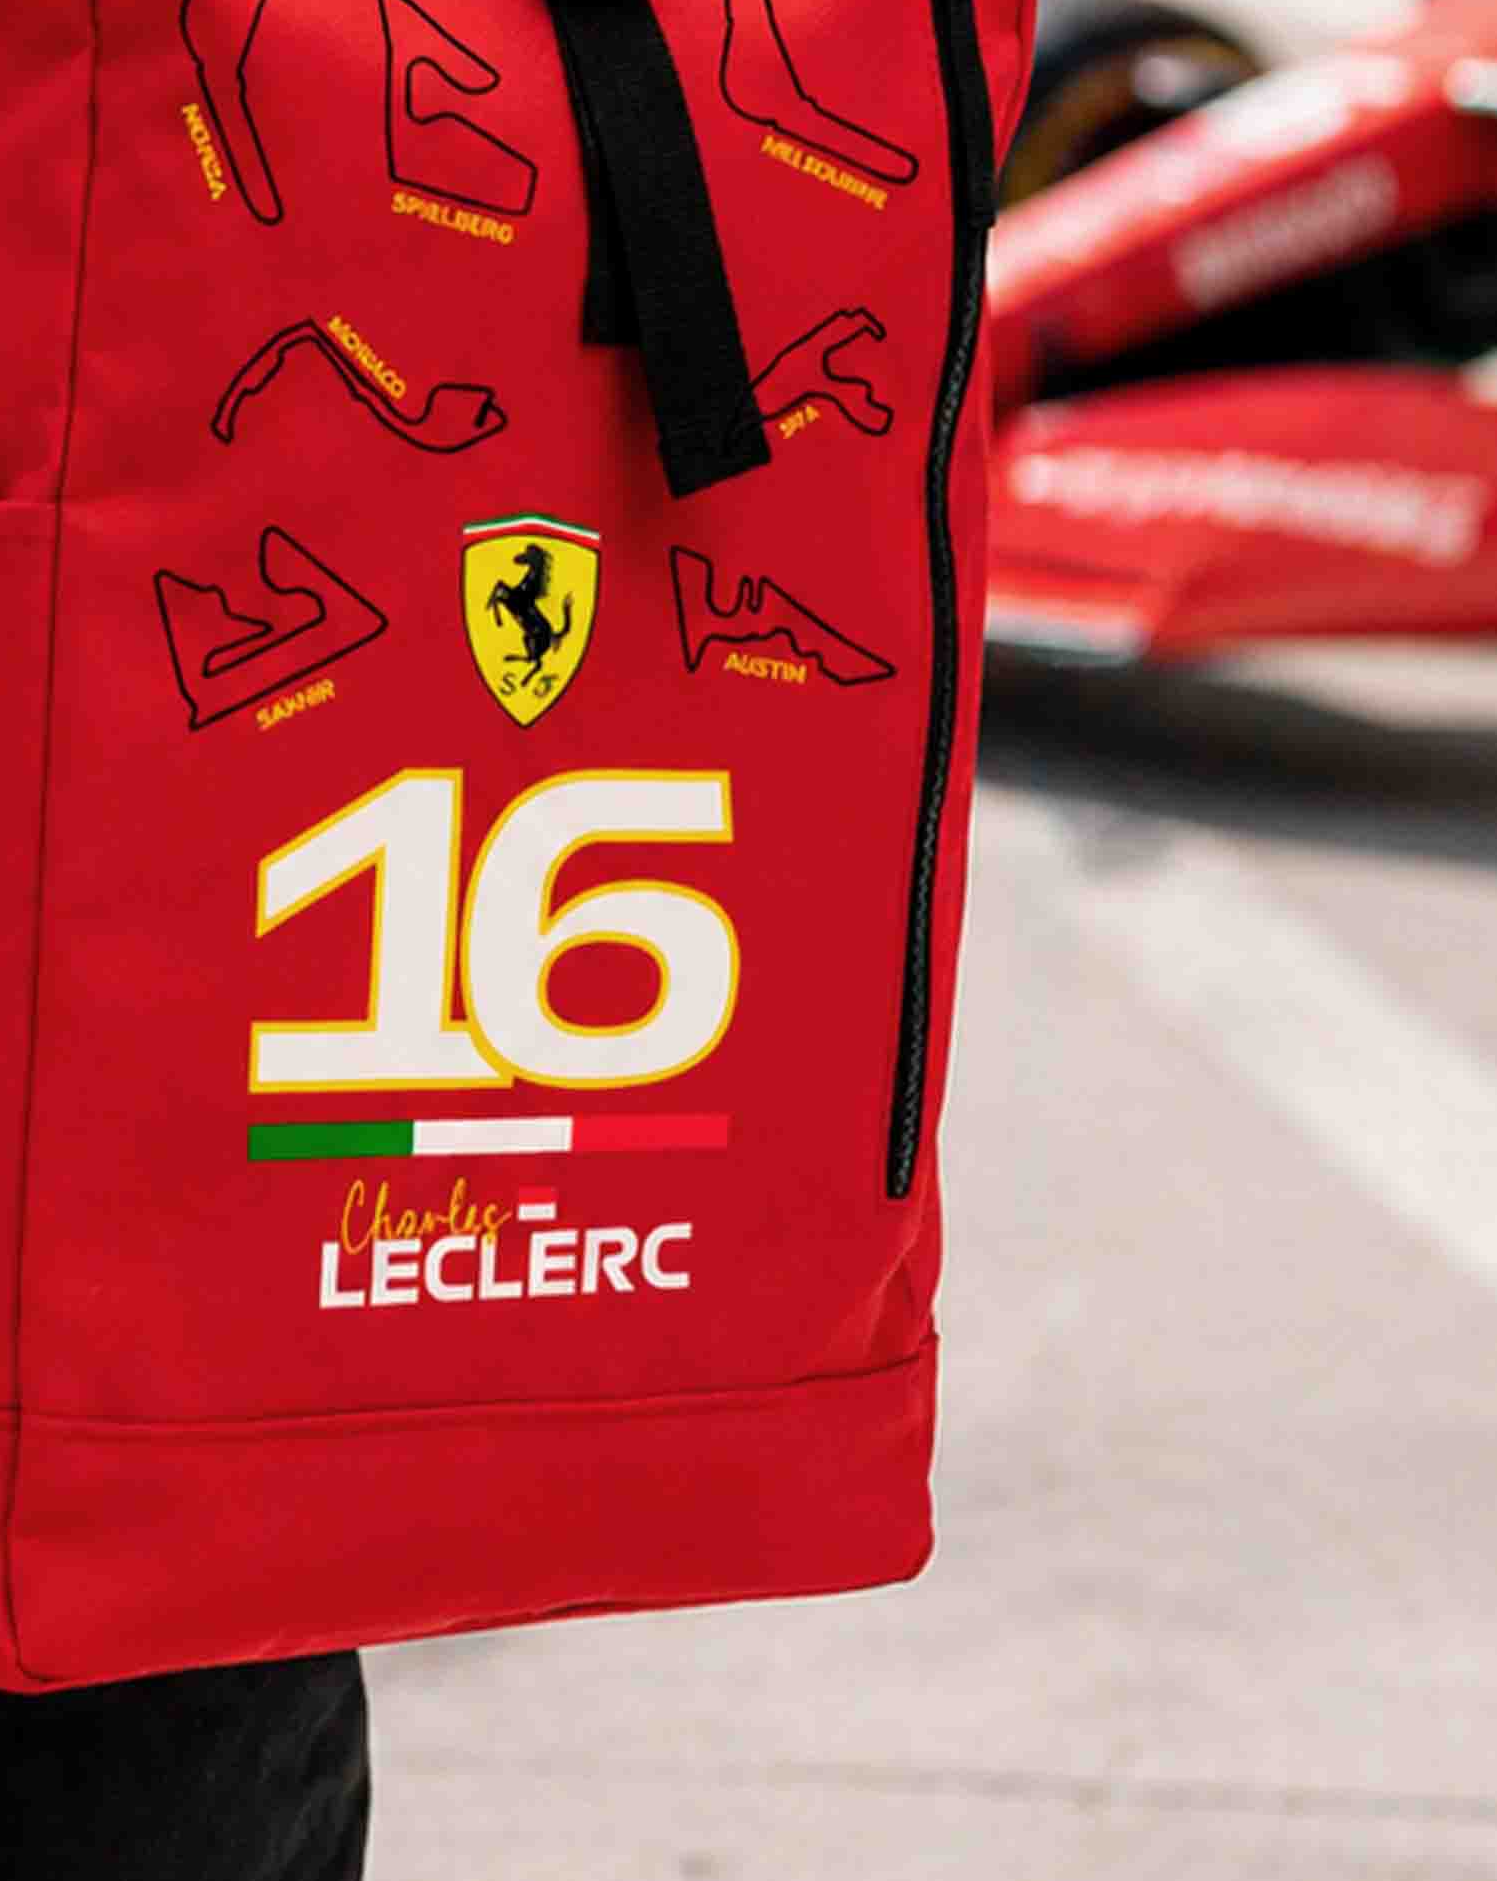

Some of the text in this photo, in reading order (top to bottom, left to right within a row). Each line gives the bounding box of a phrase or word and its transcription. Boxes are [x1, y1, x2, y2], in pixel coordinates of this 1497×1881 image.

[327, 315, 406, 400] MONACO
[724, 652, 807, 685] AUSTIN
[248, 767, 741, 1094] 16
[341, 1176, 512, 1256] Charles
[318, 1222, 693, 1310] LECLERC
